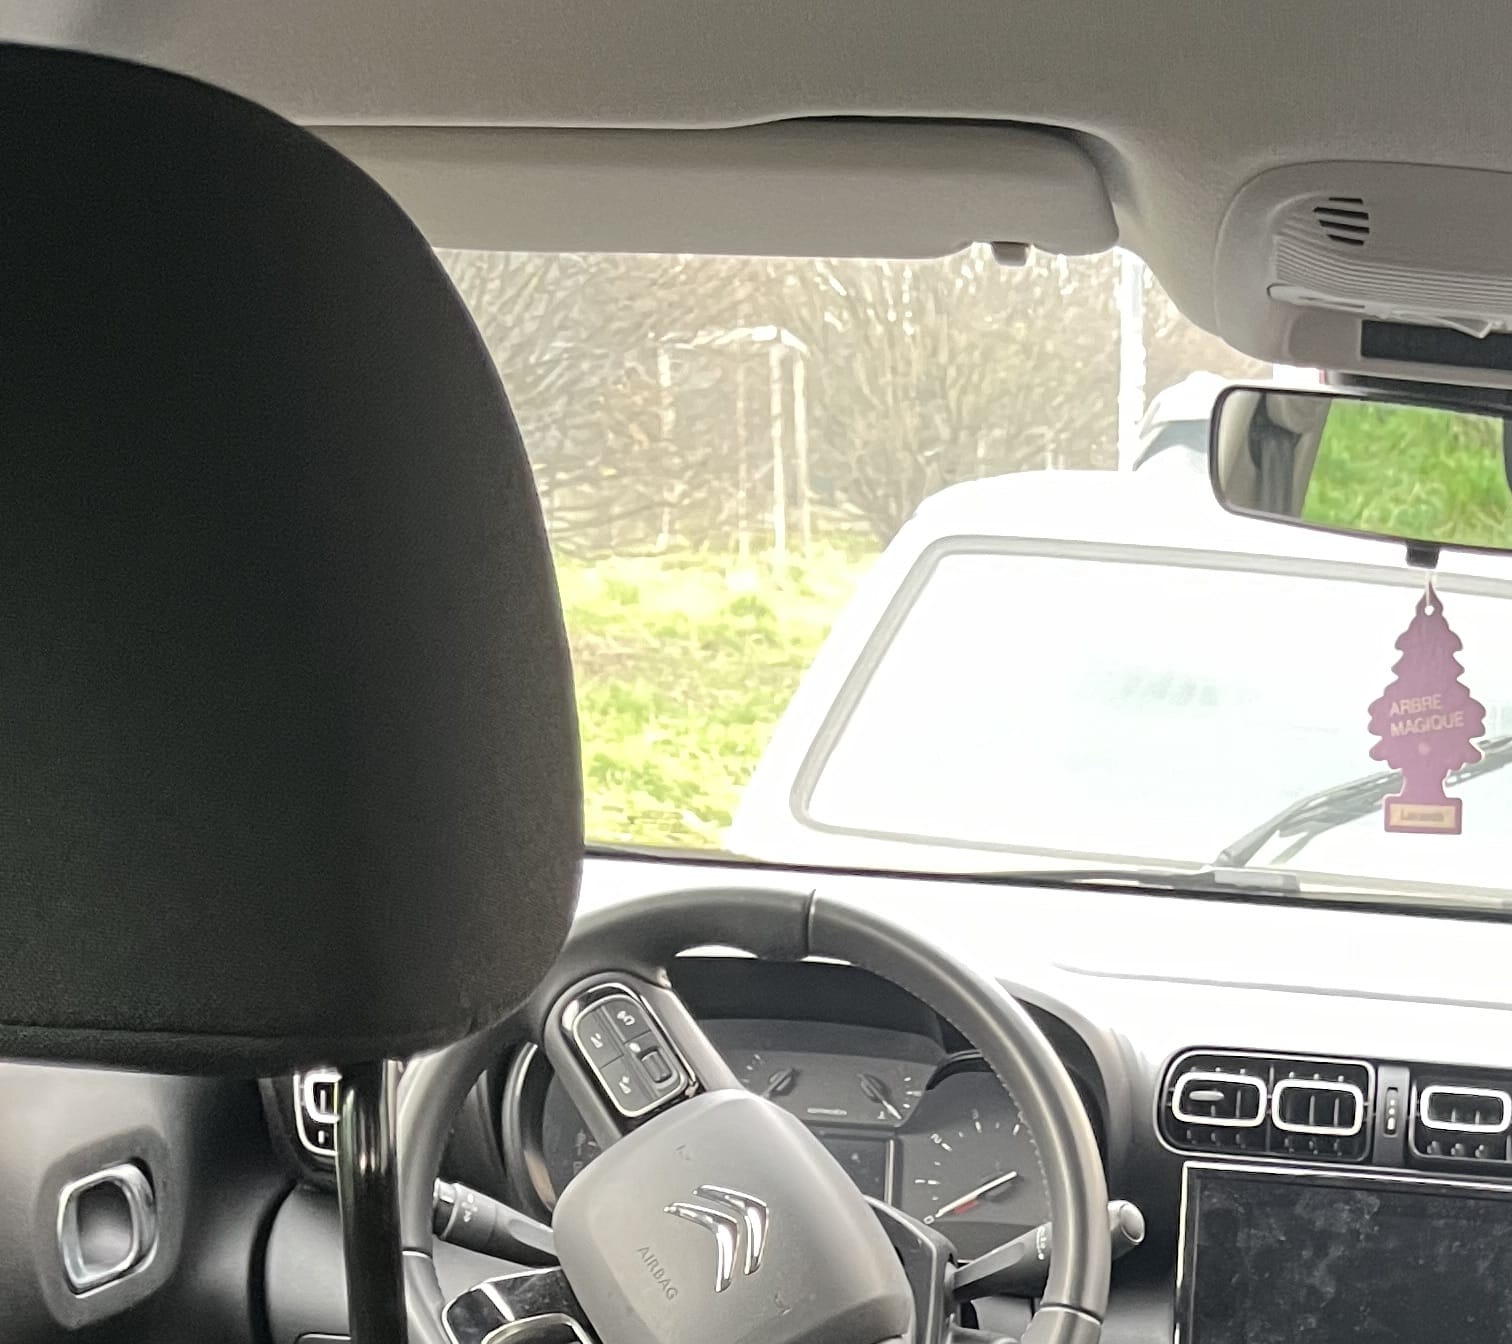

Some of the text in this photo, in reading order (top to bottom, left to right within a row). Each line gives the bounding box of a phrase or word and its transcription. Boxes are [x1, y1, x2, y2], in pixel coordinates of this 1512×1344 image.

[1390, 694, 1442, 716] ARBRE
[1390, 711, 1464, 736] MAGIQUE
[931, 1133, 942, 1144] 2
[637, 1246, 679, 1300] AIRBAG
